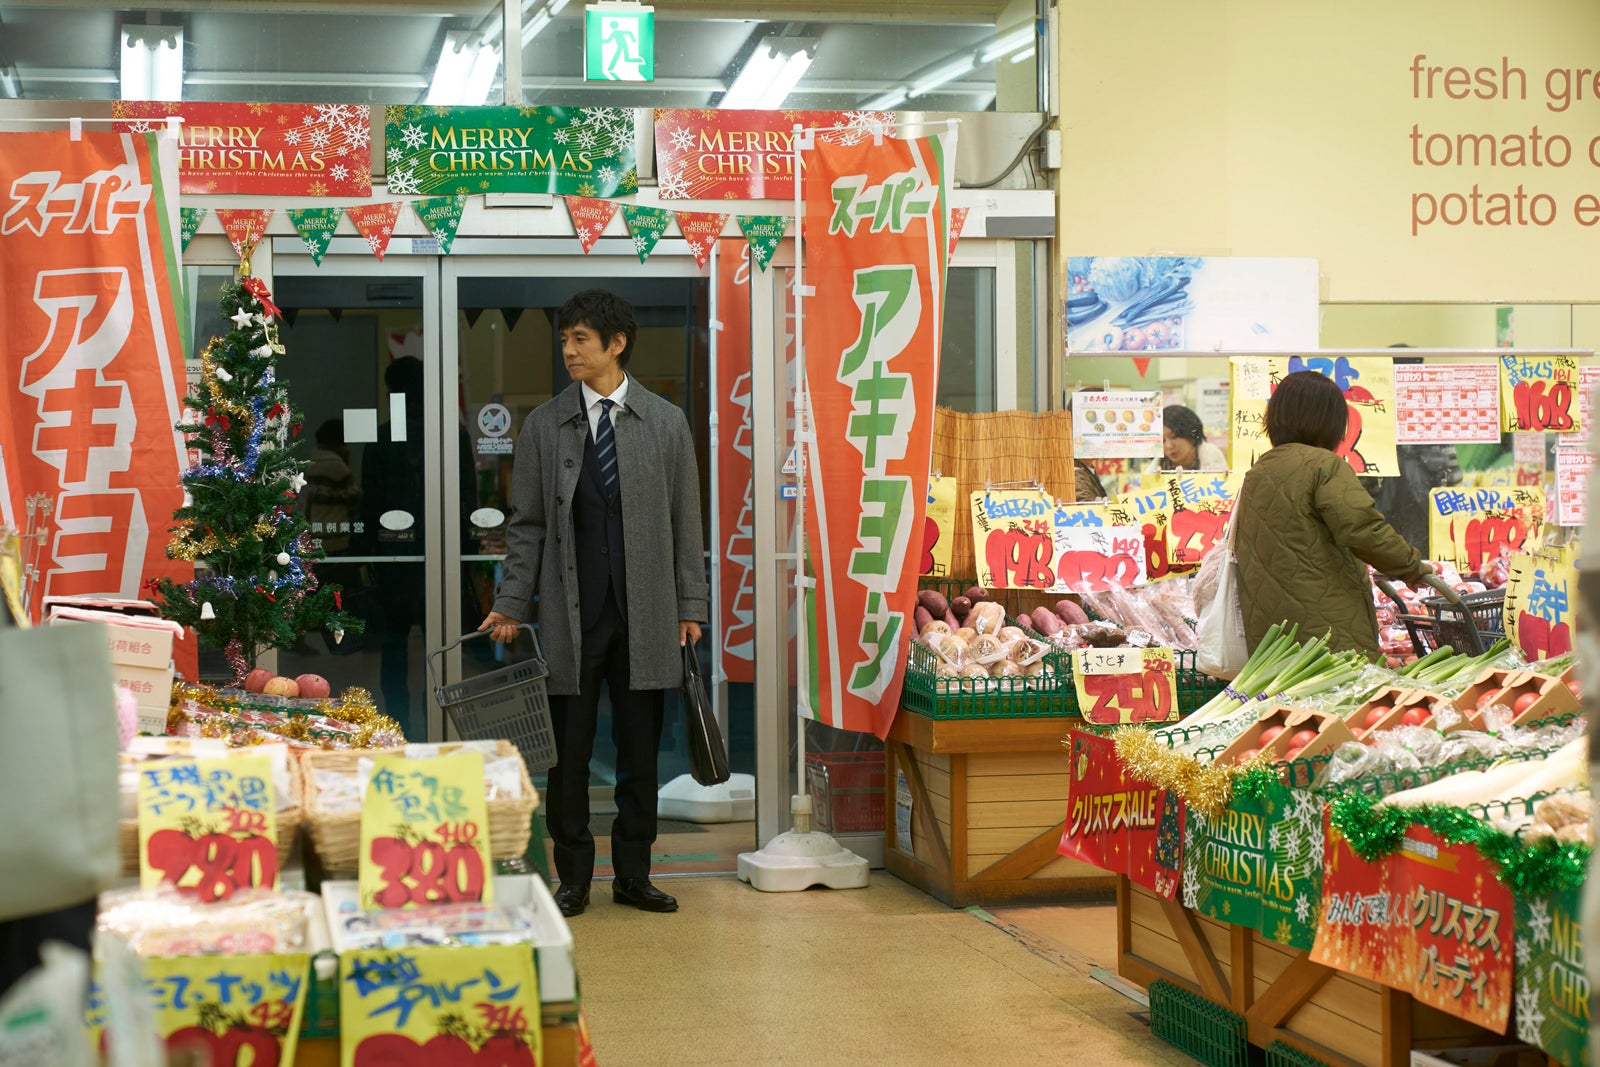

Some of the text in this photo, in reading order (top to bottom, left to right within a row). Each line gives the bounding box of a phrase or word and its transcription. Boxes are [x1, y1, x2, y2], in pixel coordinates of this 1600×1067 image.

[1410, 55, 1527, 100] fresh
[430, 125, 534, 150] MERRY
[1409, 124, 1572, 167] tomato
[178, 149, 325, 172] HRISTMAS
[429, 149, 593, 173] CHRISTMAS
[1, 165, 152, 237] スーパー
[829, 169, 938, 237] スーパー
[1412, 184, 1557, 236] potato
[1520, 357, 1552, 378] おくら
[1554, 368, 1571, 381] 181
[1513, 381, 1574, 431] 168
[17, 267, 149, 612] アキヨ
[985, 529, 1056, 588] 198
[1112, 537, 1139, 556] 149
[1143, 659, 1172, 672] 270
[1206, 808, 1266, 850] MERRY
[370, 836, 485, 909] 380
[1413, 883, 1500, 954] クリスマス
[1418, 943, 1487, 1007] パーティ
